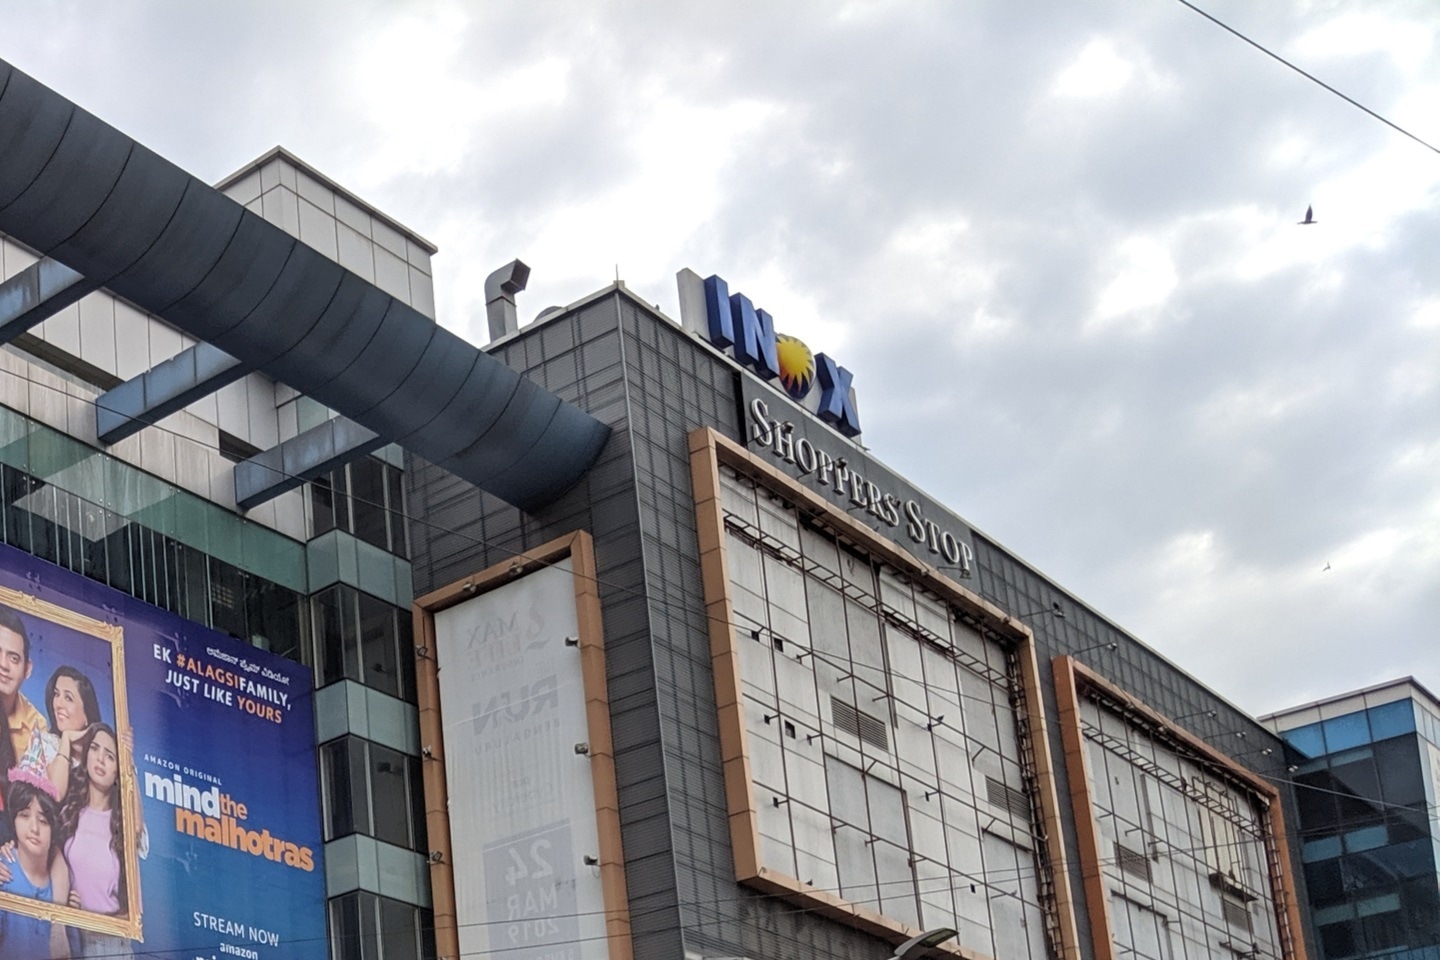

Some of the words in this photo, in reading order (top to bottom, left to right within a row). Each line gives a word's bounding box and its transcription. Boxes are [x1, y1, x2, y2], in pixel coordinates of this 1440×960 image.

[703, 274, 861, 437] INOX
[751, 398, 900, 528] SHOPPERS
[904, 499, 973, 575] STOP
[153, 643, 172, 663] EK
[165, 669, 199, 693] JUST
[203, 683, 232, 707] LIKE
[237, 695, 282, 724] YOURS
[144, 754, 180, 771] AMAZON
[183, 767, 222, 786] ORIGINAL
[144, 771, 220, 818] mind
[220, 793, 248, 820] the
[175, 807, 314, 872] malhotras
[193, 911, 244, 938] STREAM
[249, 927, 279, 947] NOW
[220, 942, 258, 960] amazon
